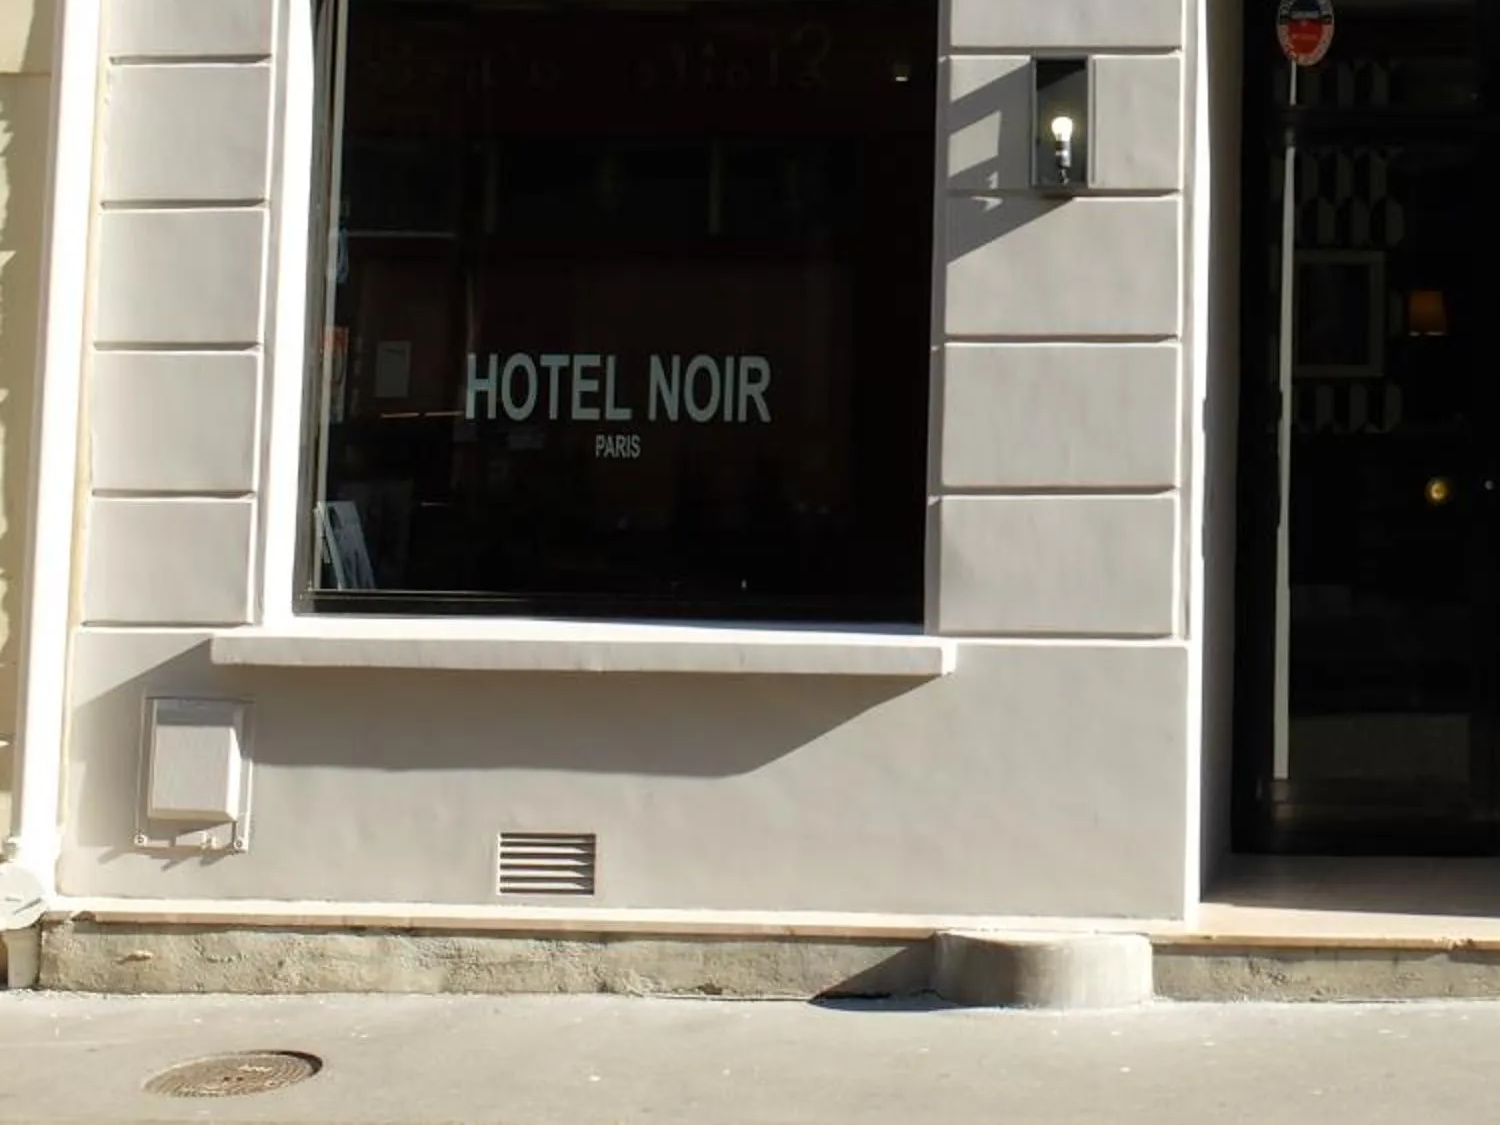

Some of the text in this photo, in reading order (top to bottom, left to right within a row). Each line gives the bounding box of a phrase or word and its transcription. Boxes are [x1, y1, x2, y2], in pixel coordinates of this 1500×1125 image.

[465, 352, 772, 422] HOTEL NOIR
[595, 434, 641, 458] PARIS
